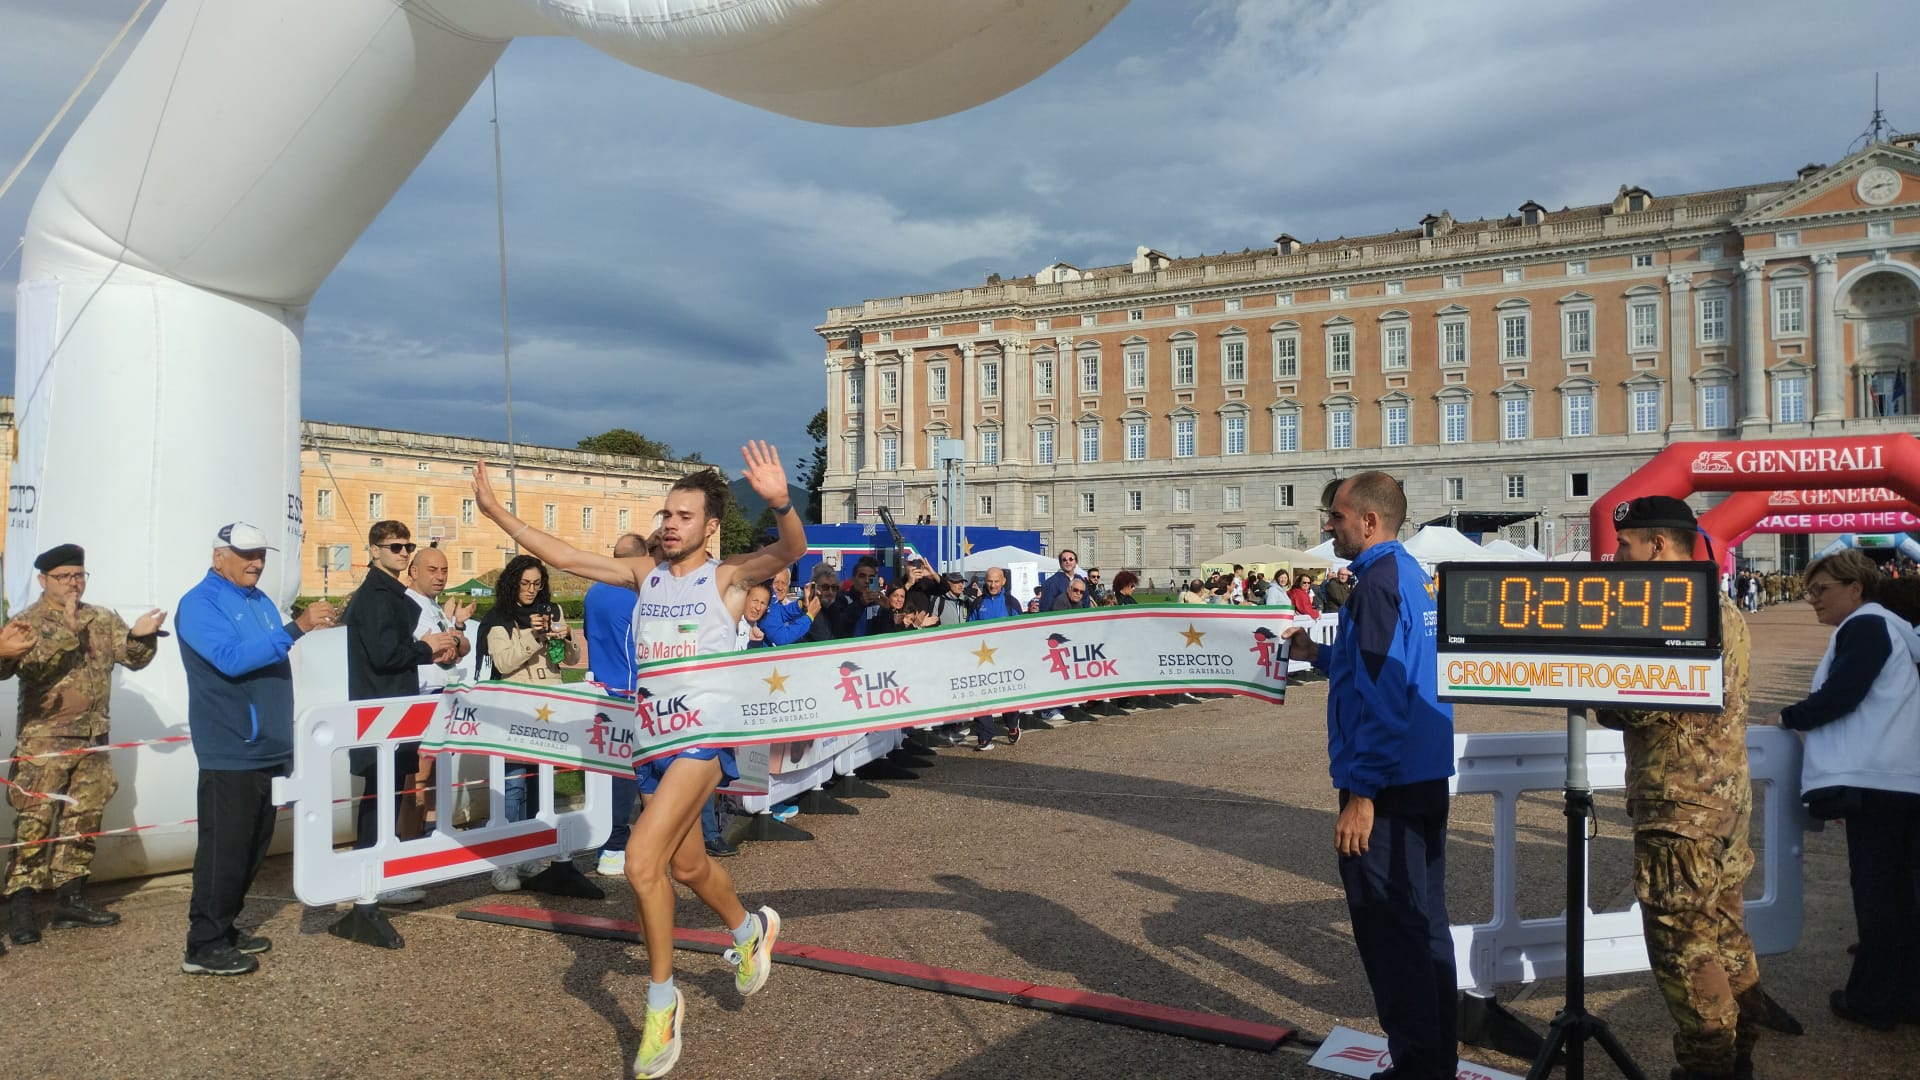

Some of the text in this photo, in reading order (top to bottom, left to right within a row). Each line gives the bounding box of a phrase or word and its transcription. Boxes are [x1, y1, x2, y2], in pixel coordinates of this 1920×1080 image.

[1736, 446, 1884, 473] GENERALI
[1801, 487, 1907, 505] GENERAL
[1818, 513, 1856, 527] FOR
[1860, 512, 1896, 526] THE
[640, 602, 707, 618] ESERCITO
[1499, 577, 1692, 631] 0:29:43
[637, 640, 697, 660] De Marchi
[1072, 643, 1106, 662] LIK
[1075, 659, 1119, 680] LOK
[1158, 654, 1233, 667] ESERCITO
[865, 670, 899, 691] LIK
[950, 668, 1025, 691] ESERCITO
[1447, 661, 1711, 689] CRONOMETROGARA.IT
[866, 686, 912, 709] LOK
[980, 683, 1027, 696] GARIBALDI
[454, 707, 478, 722] LIK
[656, 694, 689, 716] LIK
[740, 697, 817, 717] ESERCITO
[657, 709, 703, 736] LOK
[771, 712, 820, 724] GARIBALDI
[450, 721, 481, 736] LOK
[509, 724, 570, 743] ESERCITO
[610, 726, 634, 744] LIK
[608, 741, 632, 759] LO
